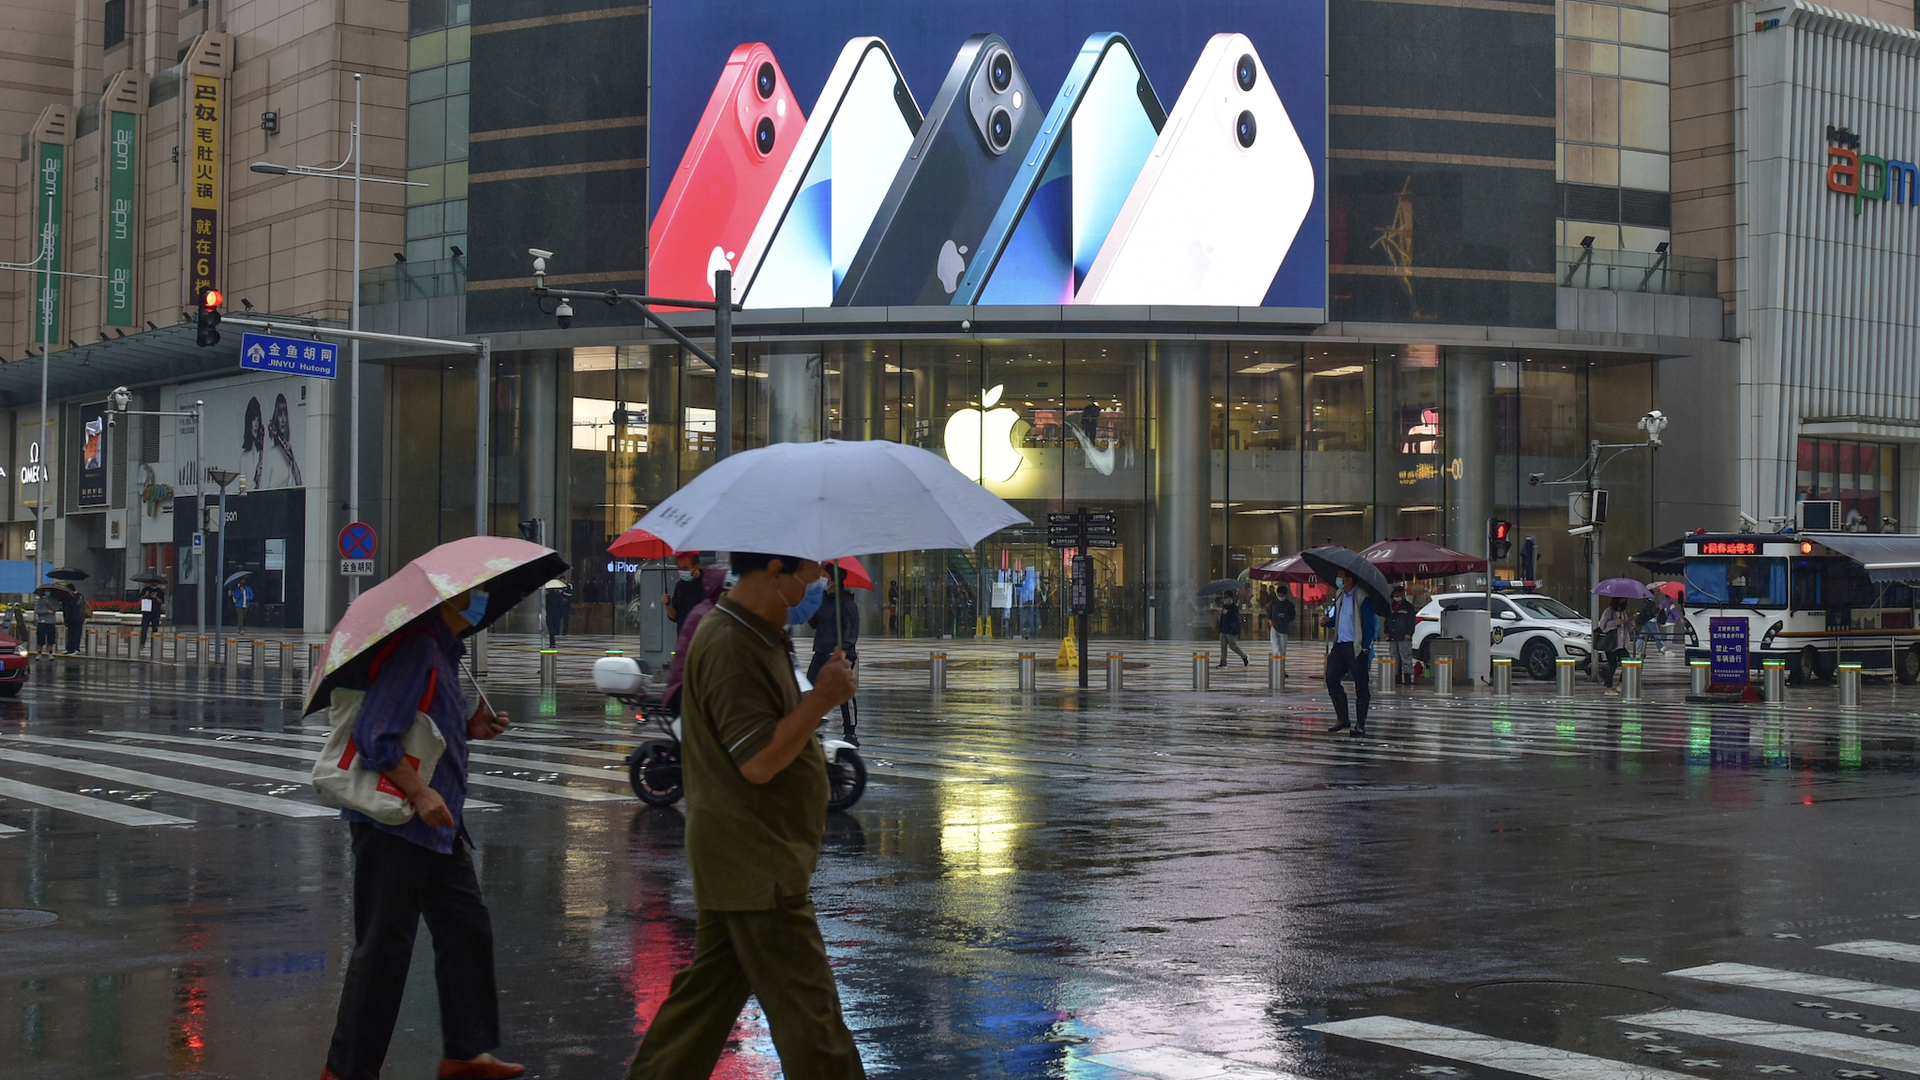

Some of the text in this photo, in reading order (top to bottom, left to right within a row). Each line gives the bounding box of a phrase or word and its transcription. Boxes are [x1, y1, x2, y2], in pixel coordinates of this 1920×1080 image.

[112, 129, 129, 170] apm
[1826, 146, 1919, 215] apm
[111, 199, 127, 239] apm
[110, 268, 126, 309] apm
[268, 342, 332, 362] 金鱼胡同
[268, 359, 331, 374] JINYU Hutong
[225, 511, 238, 521] son
[342, 562, 372, 573] 金鱼胡同
[1715, 644, 1742, 653] 禁止一切
